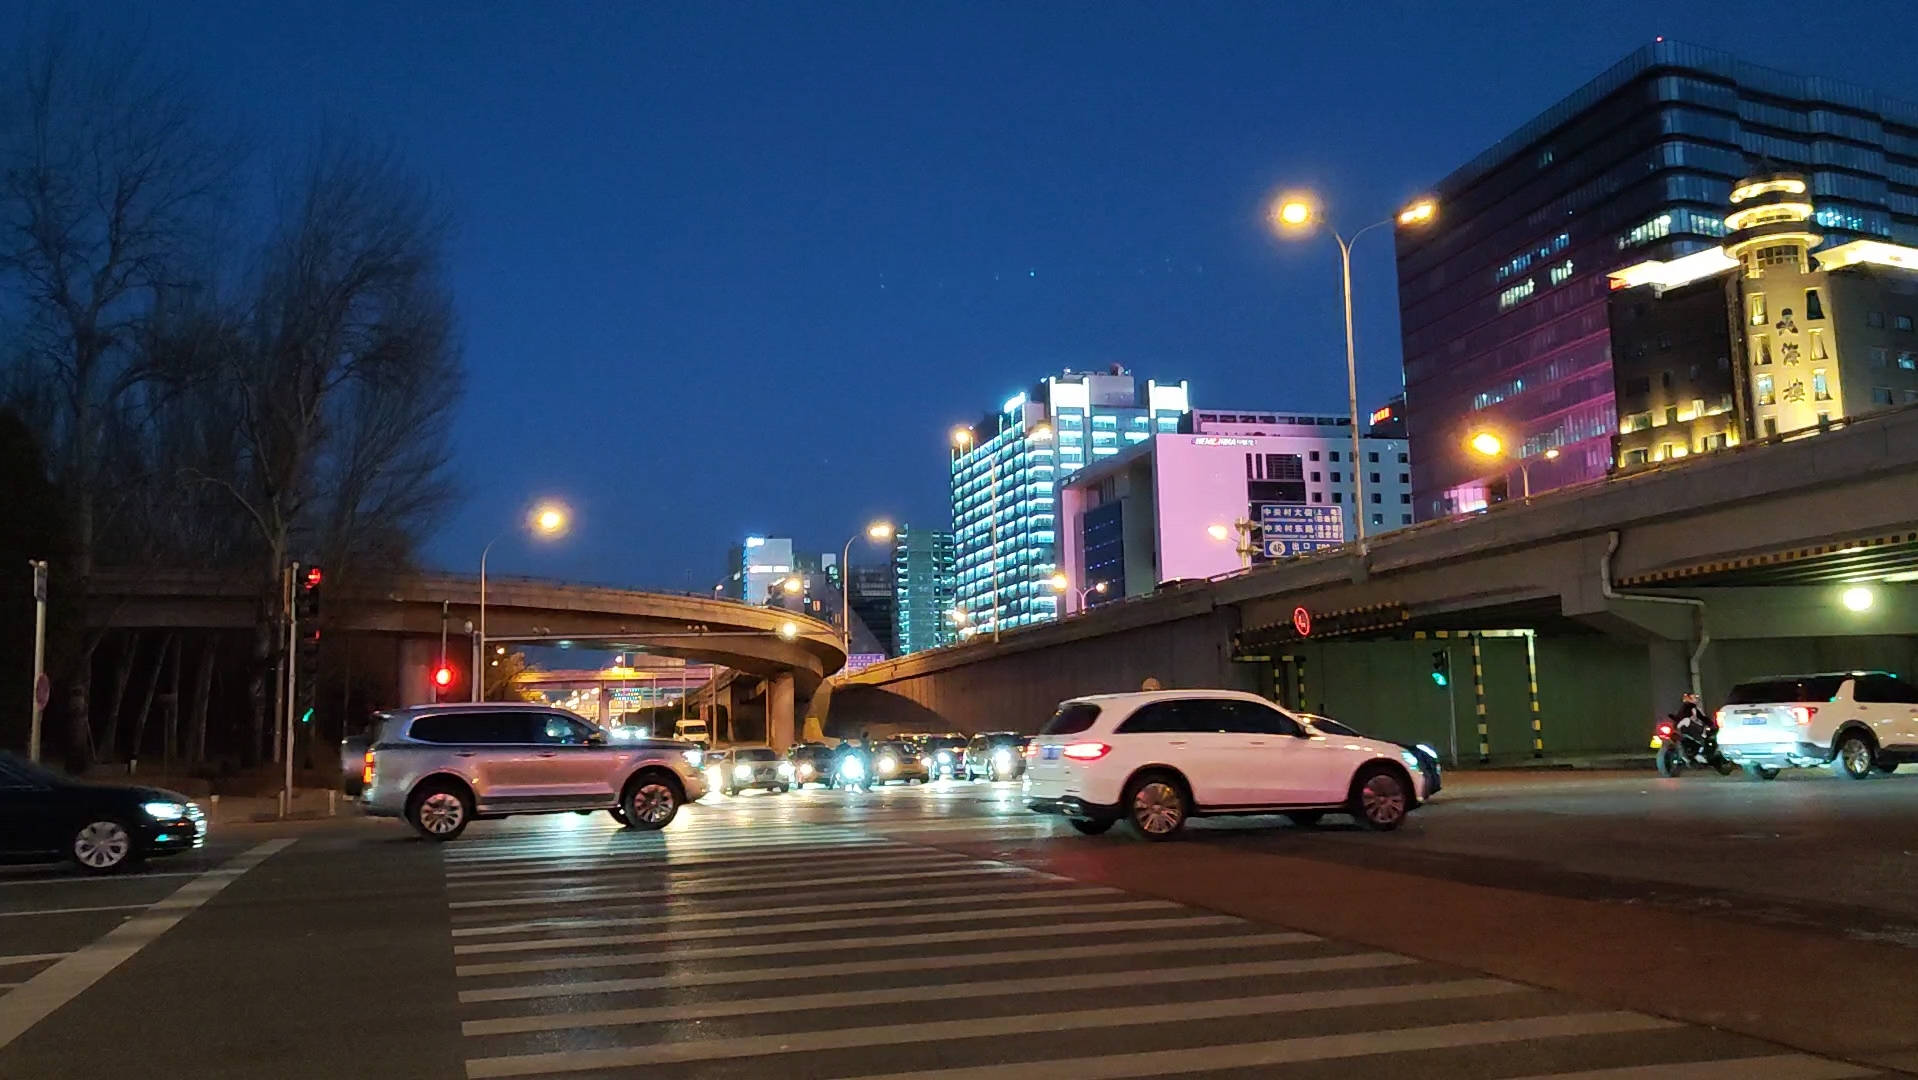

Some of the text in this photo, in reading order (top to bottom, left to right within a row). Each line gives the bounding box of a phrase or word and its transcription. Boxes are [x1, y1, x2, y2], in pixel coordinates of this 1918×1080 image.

[1263, 508, 1313, 517] 中关村大街
[1264, 525, 1314, 534] 中关村东路
